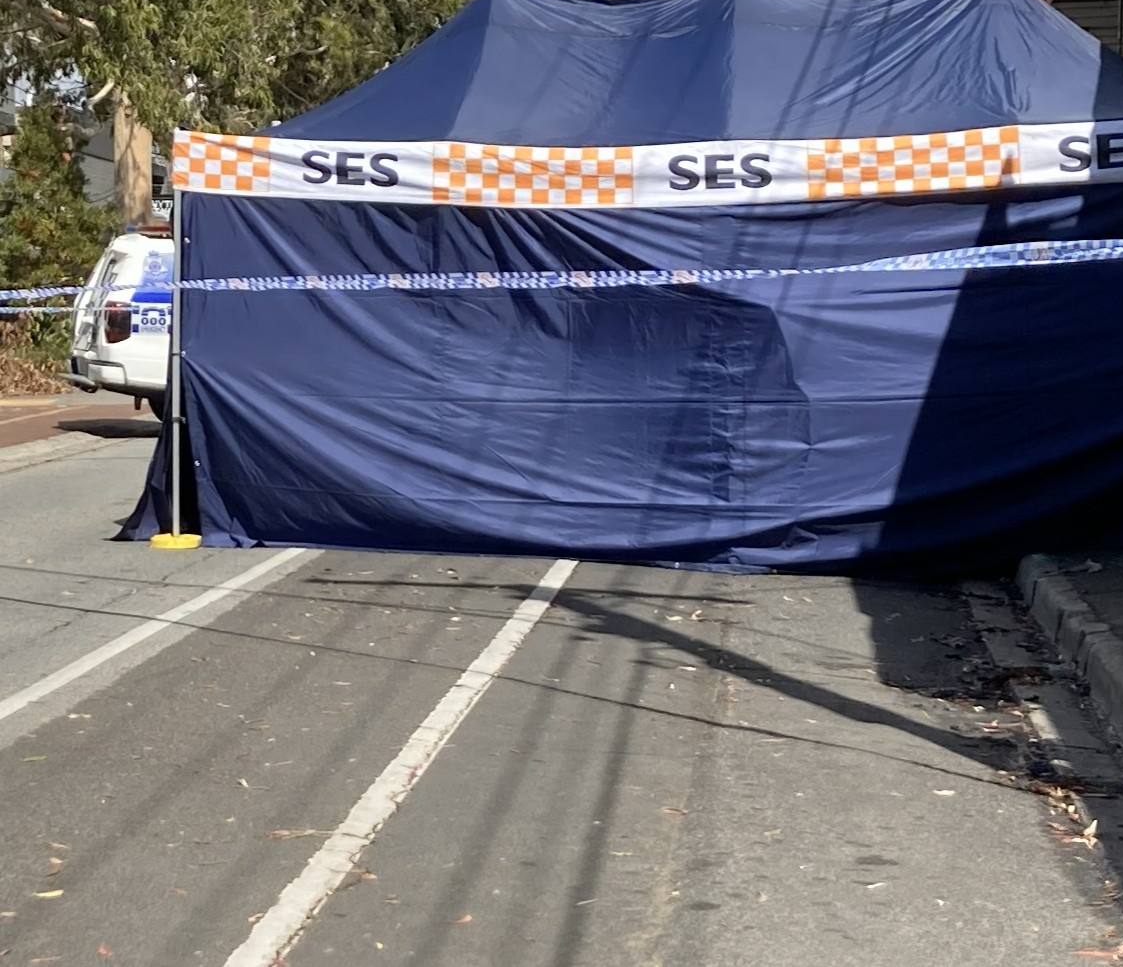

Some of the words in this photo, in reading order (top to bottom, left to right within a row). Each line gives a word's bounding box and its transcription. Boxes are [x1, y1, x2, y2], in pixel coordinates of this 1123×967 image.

[301, 150, 399, 188] SES
[668, 152, 772, 191] SES
[141, 317, 167, 326] 000
